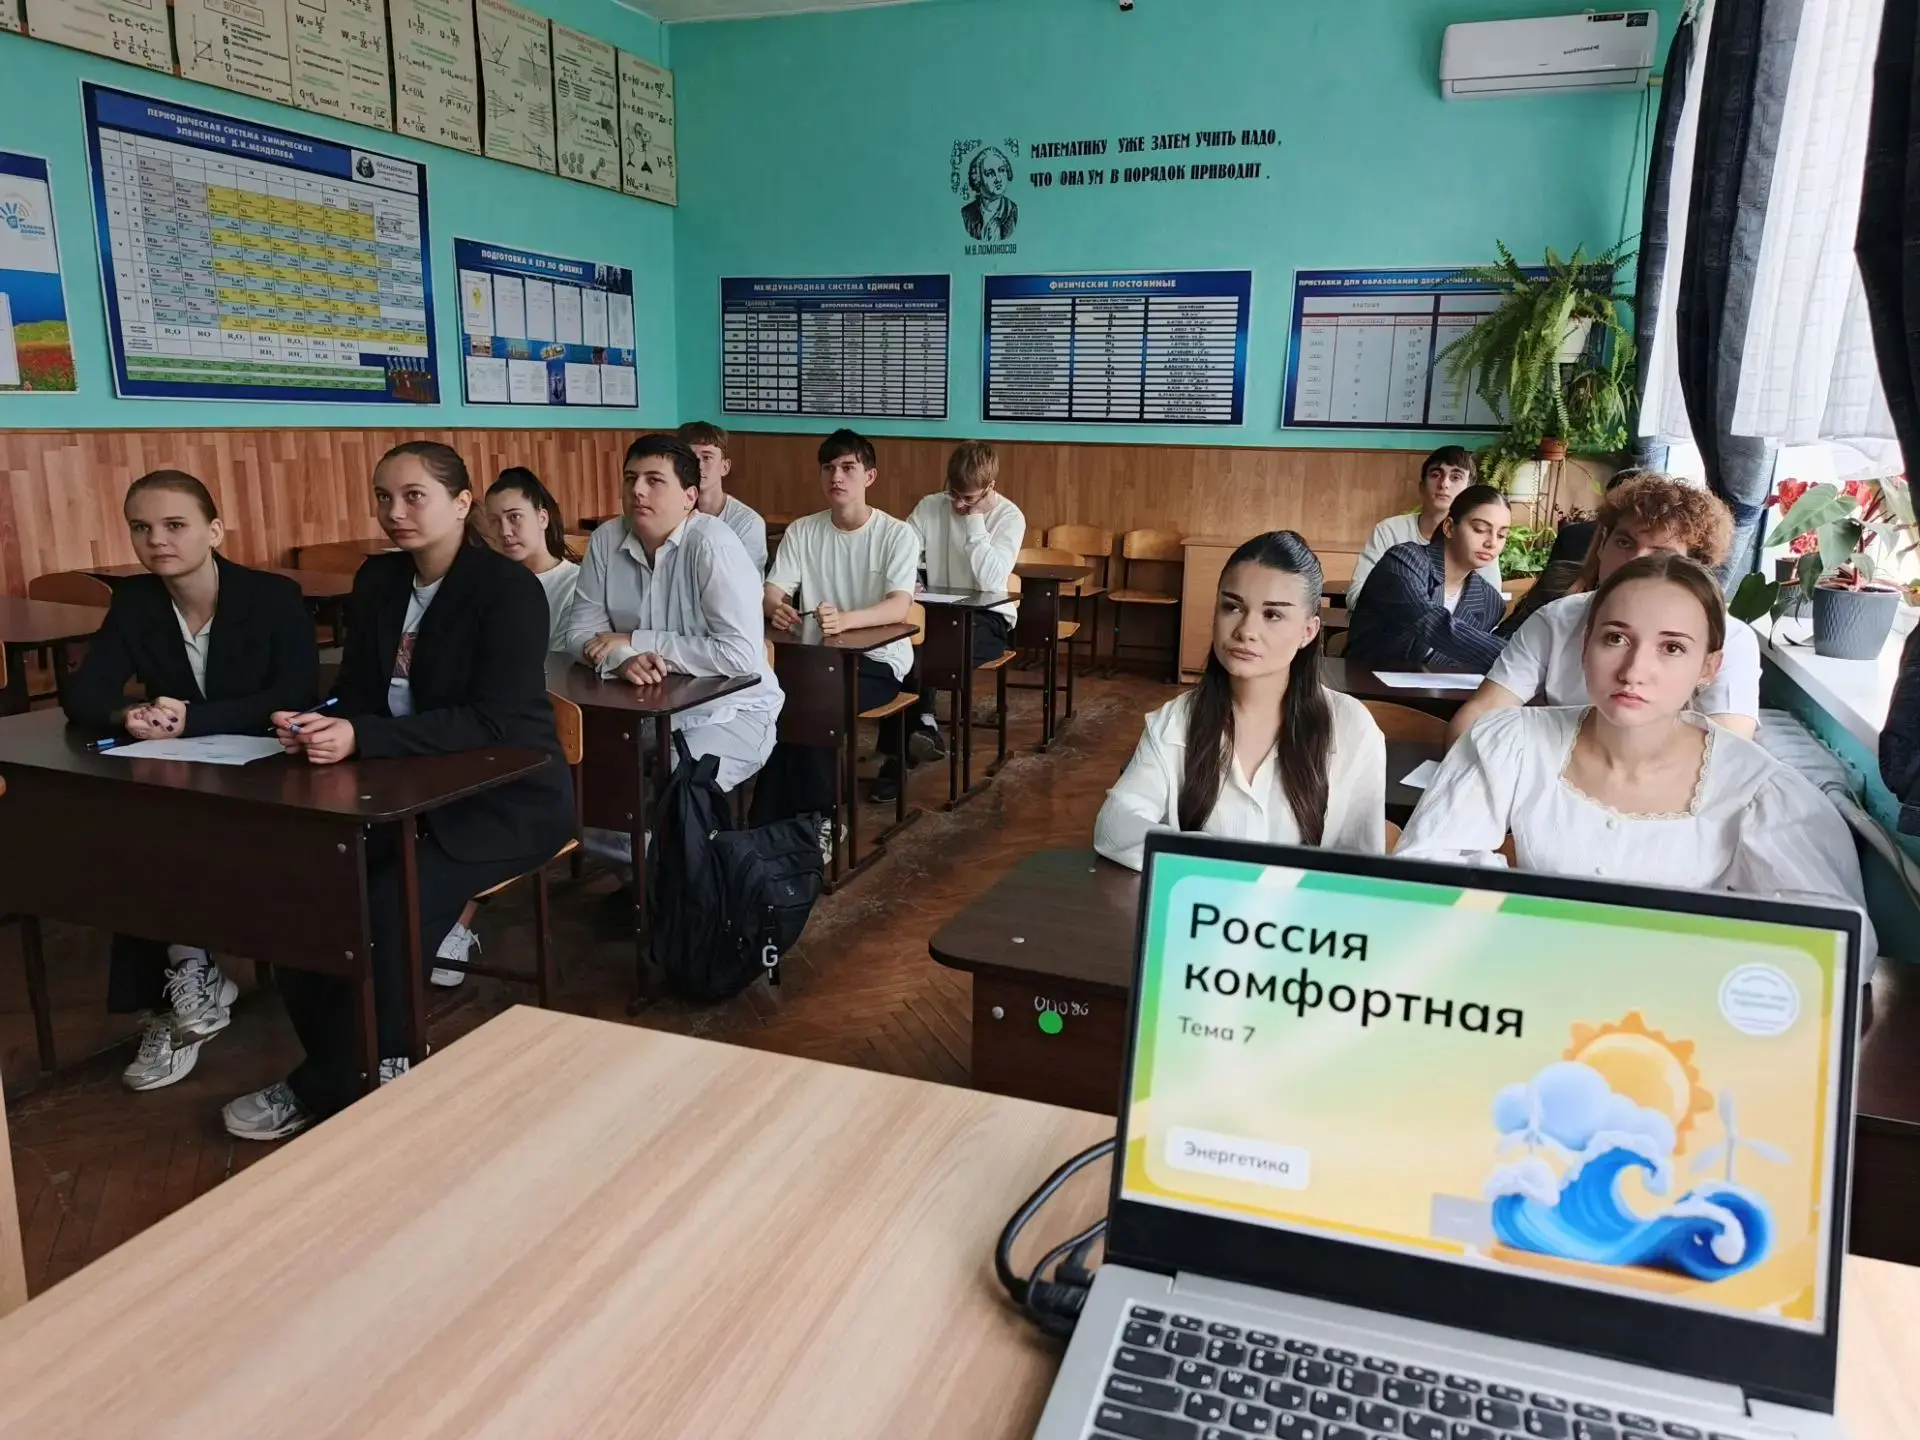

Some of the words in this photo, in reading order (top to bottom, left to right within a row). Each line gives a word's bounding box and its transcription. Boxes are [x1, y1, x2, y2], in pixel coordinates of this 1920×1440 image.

[147, 108, 221, 132] ПЕРИОДИЧЕСКАЯ
[224, 126, 260, 141] СИСТЕМА
[262, 136, 312, 153] ХИМИЧЕСКИХ
[176, 127, 226, 144] ЭЛЕМЕНТОВ
[1031, 139, 1107, 159] МАТЕМАТИКУ
[1118, 136, 1145, 154] УЖЕ
[1151, 132, 1190, 152] ЗАТЕМ
[1196, 130, 1236, 148] УЧИТЬ
[1030, 172, 1052, 188] ЧТО
[1060, 170, 1084, 186] ОНА
[1088, 170, 1104, 184] УМ
[1110, 168, 1118, 184] В
[1124, 164, 1185, 182] ПОРЯДОК
[1190, 162, 1261, 180] ПРИВОДИТ
[481, 250, 527, 266] ПОДГОТОВКА
[535, 259, 546, 268] ЕГЭ
[547, 261, 557, 270] ПО
[558, 263, 583, 275] ФИЗИКЕ
[754, 283, 825, 292] МЕЖДУНАРОДНАЯ
[828, 283, 864, 291] СИСТЕМА
[867, 282, 900, 291] ЕДИНИЦ
[1049, 280, 1108, 290] ФИЗИЧЕСКИЕ
[1112, 280, 1176, 288] ПОСТОЯННЫЕ
[1190, 903, 1368, 961] Россия
[762, 944, 779, 967] G
[1184, 964, 1523, 1038] комфортная
[1178, 1016, 1234, 1042] Тема
[1242, 1026, 1256, 1044] 7
[1184, 1140, 1290, 1174] Энергетика
[1228, 1371, 1243, 1383] W
